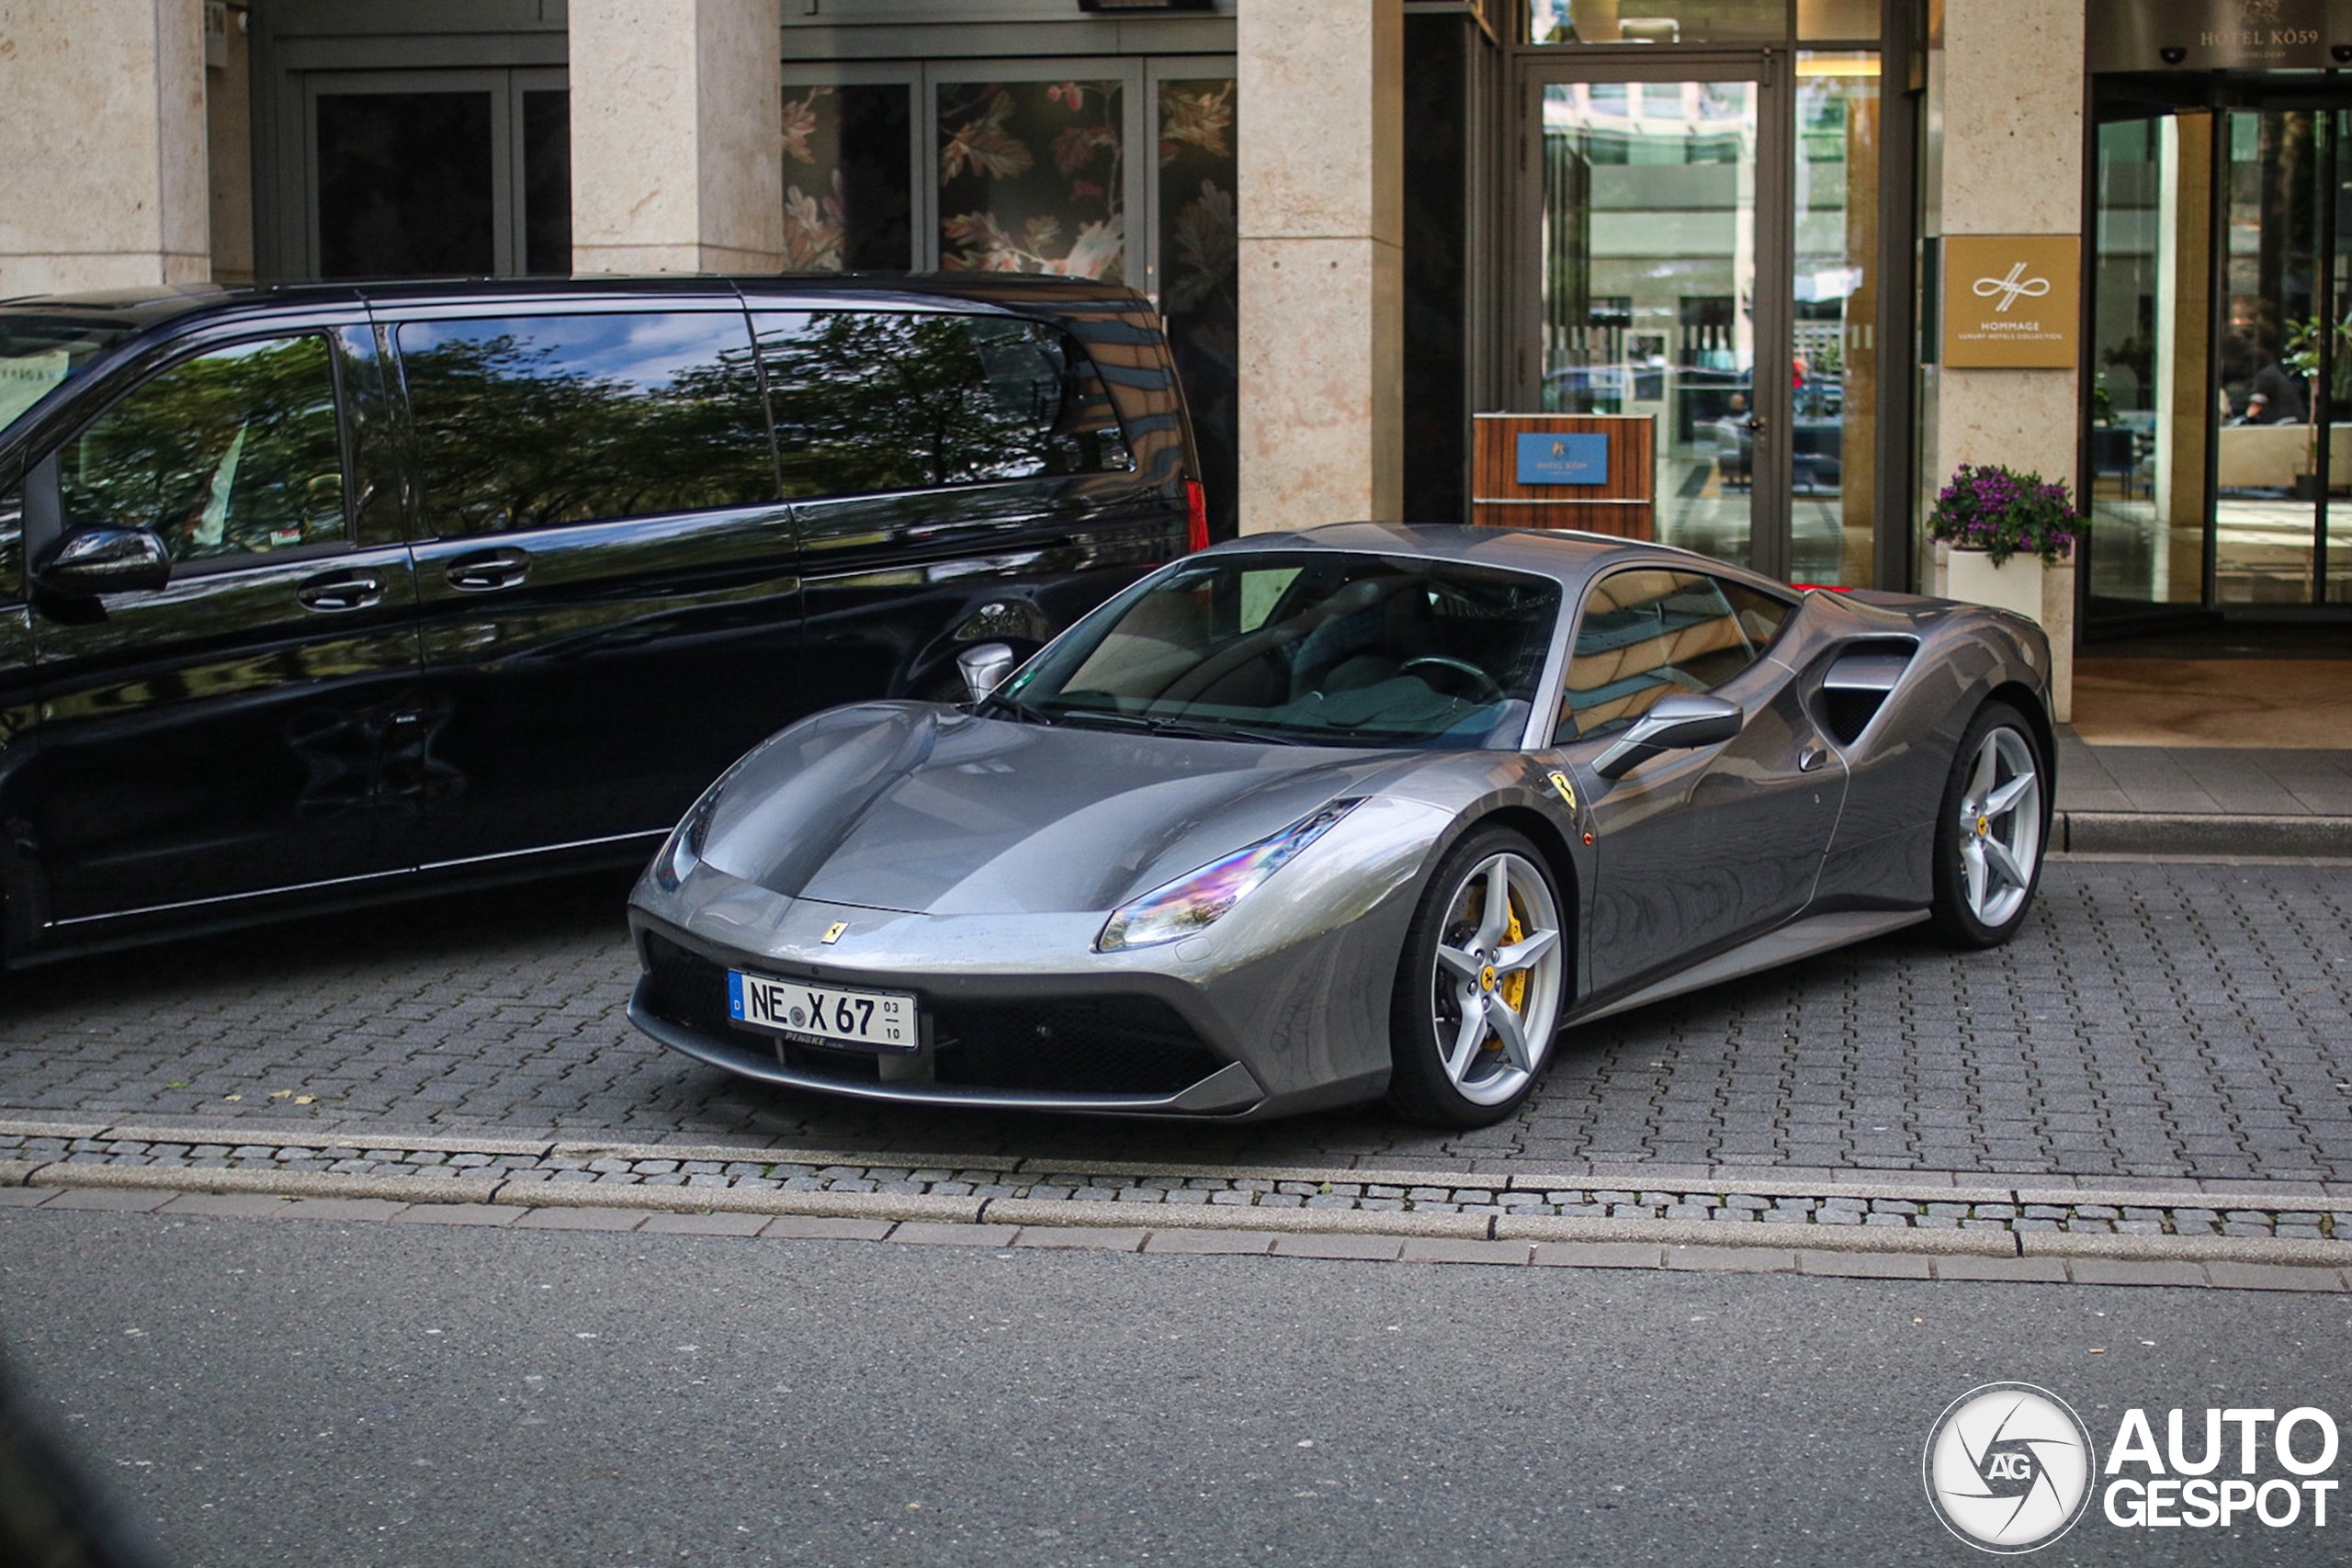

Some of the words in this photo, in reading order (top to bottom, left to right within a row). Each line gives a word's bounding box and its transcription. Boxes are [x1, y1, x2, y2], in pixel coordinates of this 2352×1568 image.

[2200, 31, 2264, 46] HOTEL
[1980, 321, 2040, 332] HOMMAGE
[734, 998, 741, 1011] D
[751, 981, 788, 1024] NE
[807, 992, 828, 1031] X
[835, 997, 875, 1036] 67
[883, 1001, 899, 1013] 03
[887, 1028, 900, 1040] 10
